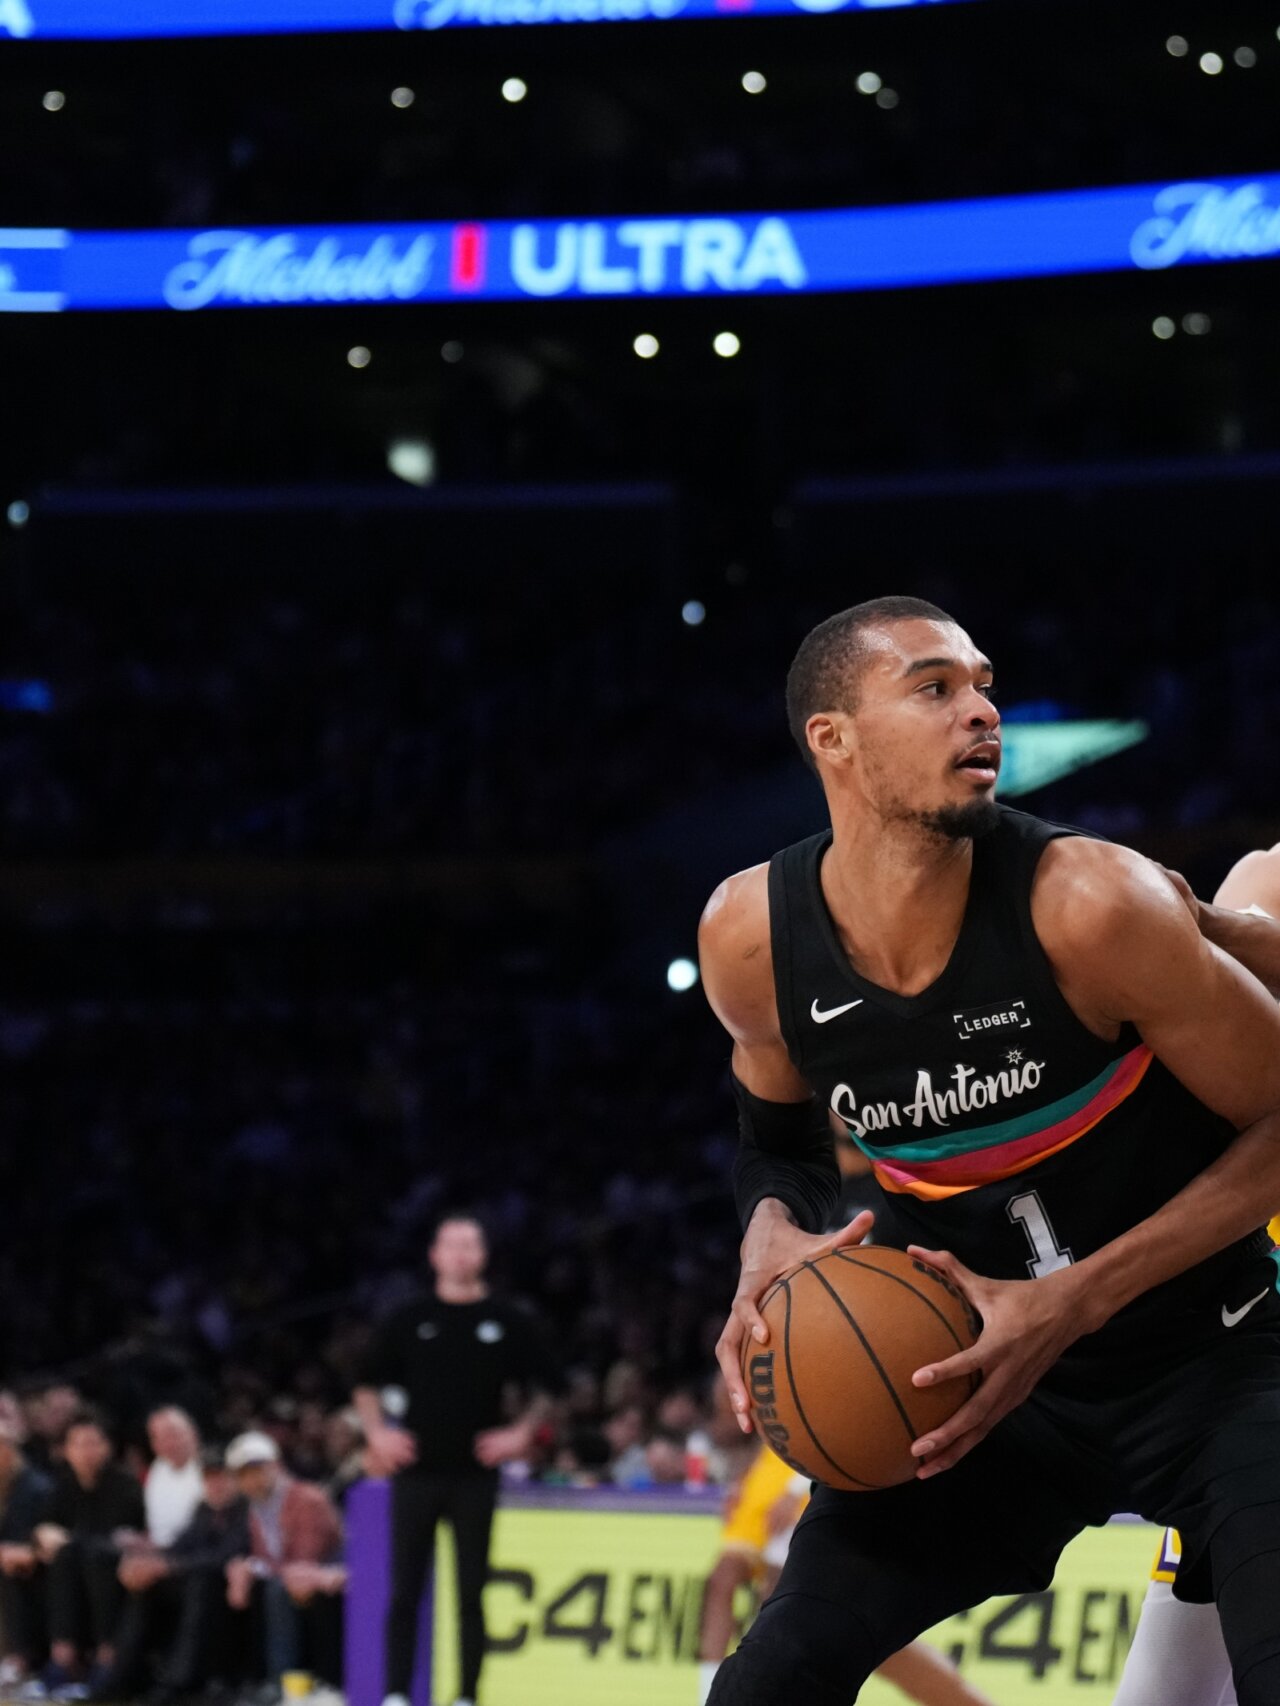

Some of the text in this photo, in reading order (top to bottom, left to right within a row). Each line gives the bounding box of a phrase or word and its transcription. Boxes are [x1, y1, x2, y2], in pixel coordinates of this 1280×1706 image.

[509, 217, 808, 297] ULTRA
[963, 1010, 1019, 1033] LEDGER
[830, 1059, 1046, 1138] San Antonio
[1005, 1190, 1075, 1280] 1
[485, 1567, 614, 1660] C4
[948, 1592, 1062, 1681] 4
